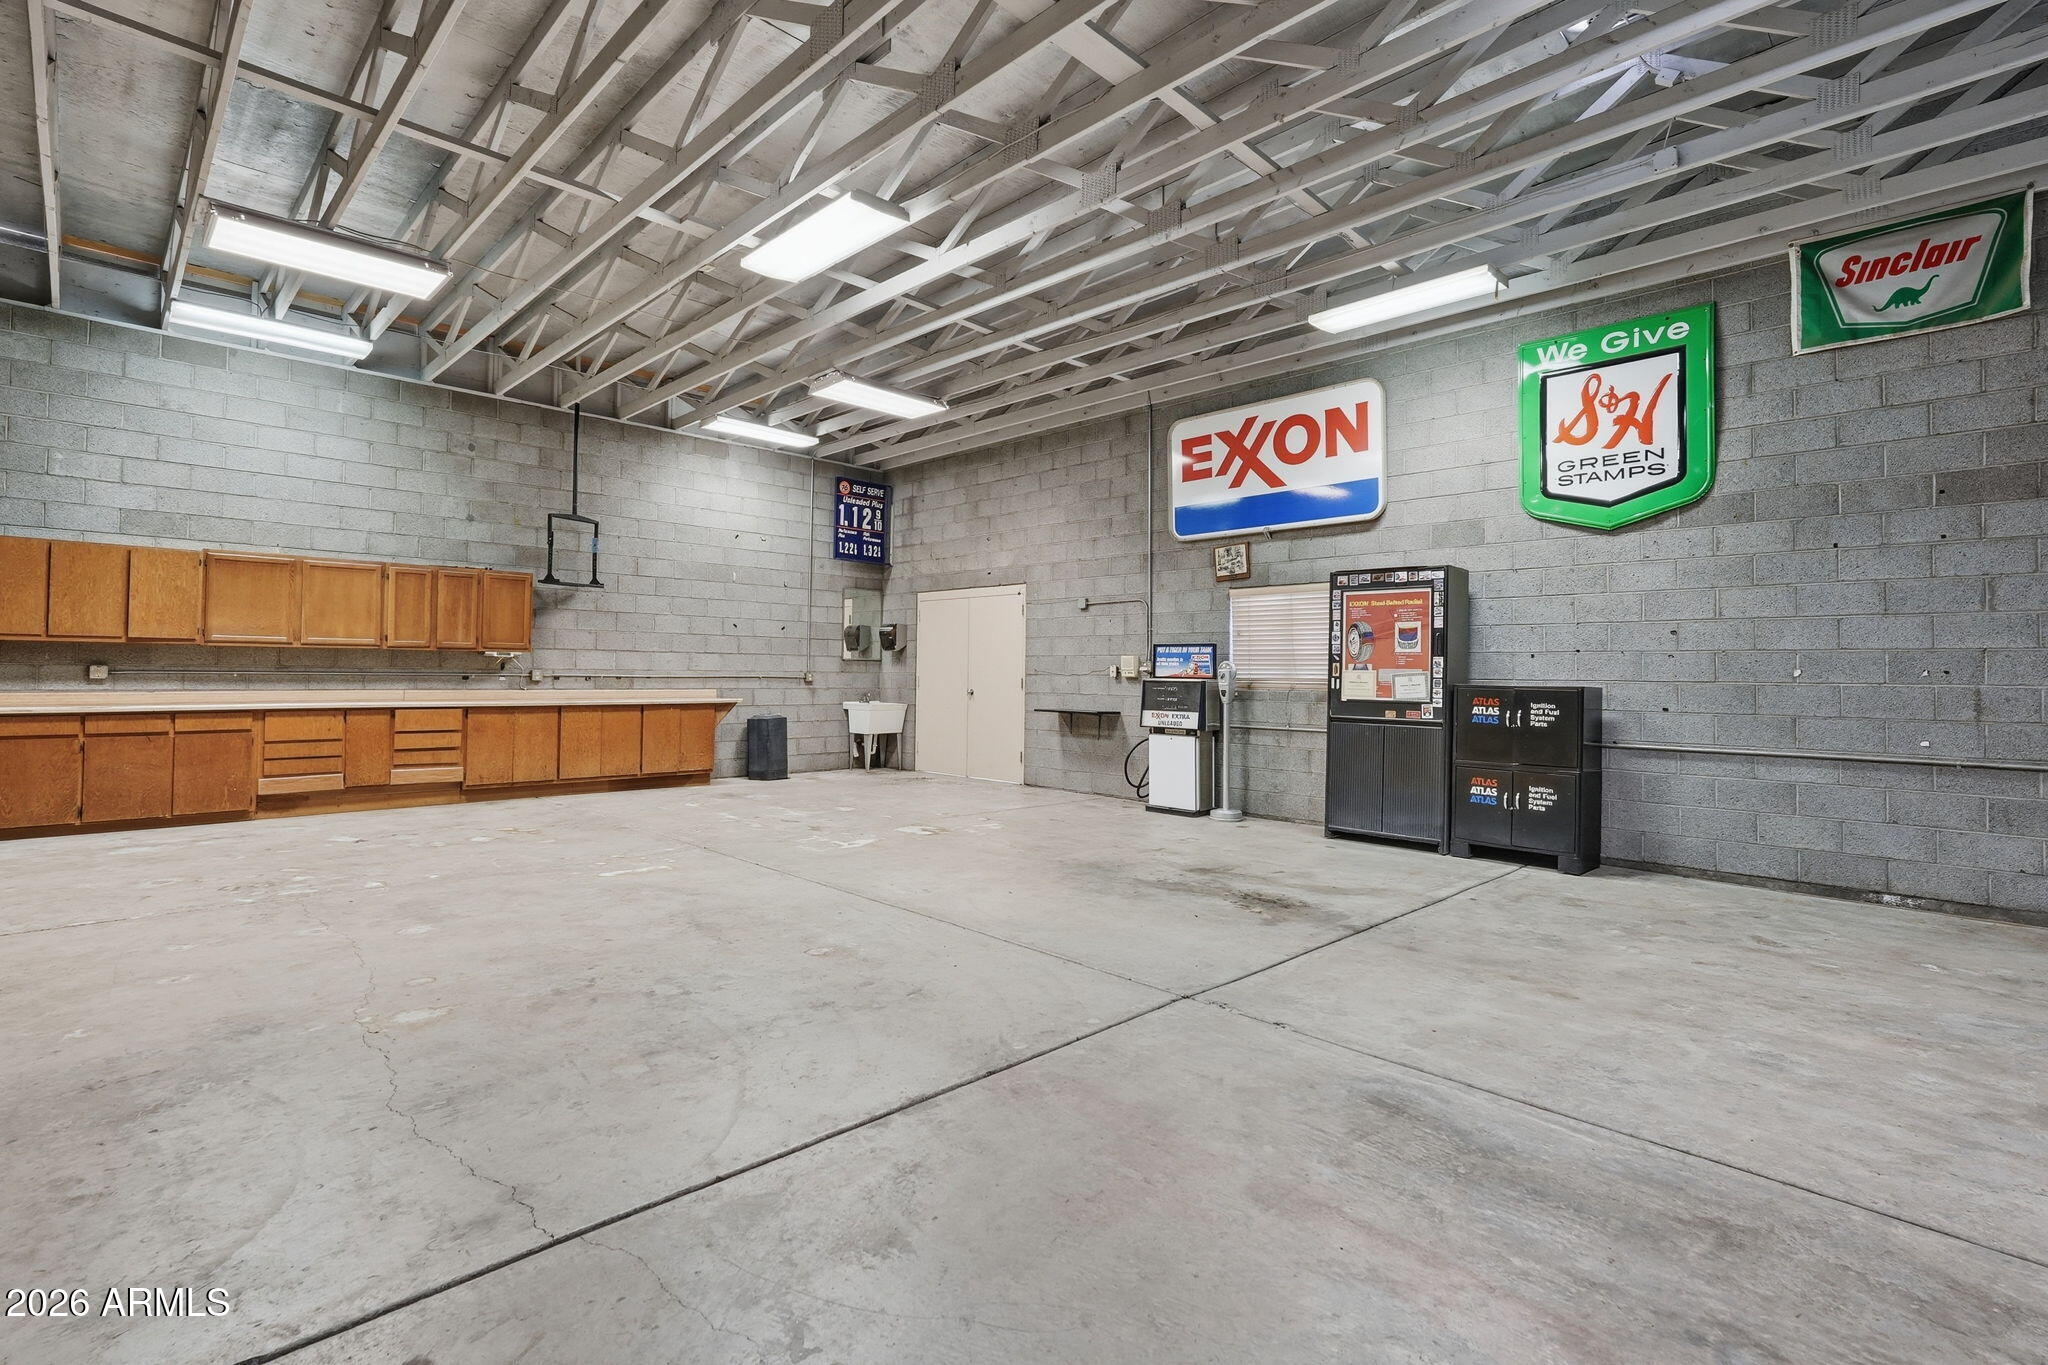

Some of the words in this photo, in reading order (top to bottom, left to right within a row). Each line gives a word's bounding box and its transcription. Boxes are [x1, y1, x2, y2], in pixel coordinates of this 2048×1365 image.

[1835, 234, 1983, 288] Sinclair
[1537, 342, 1588, 363] We
[1601, 321, 1690, 354] Give
[1552, 373, 1673, 449] S&H
[1181, 400, 1369, 489] EXXON
[1557, 447, 1665, 473] GREEN
[1557, 463, 1667, 487] STAMPS
[852, 484, 866, 494] SELF
[867, 487, 885, 497] SERVE
[843, 496, 870, 506] Unleaded
[871, 500, 883, 509] Plus
[874, 521, 883, 531] 10
[1472, 697, 1499, 706] ATLAS
[1472, 706, 1499, 715] ATLAS
[1472, 715, 1499, 724] ATLAS
[1530, 714, 1555, 722] System
[1470, 777, 1498, 787] ATLAS
[1470, 786, 1498, 796] ATLAS
[1528, 785, 1554, 794] Ignition
[1470, 795, 1497, 806] ATLAS
[1528, 798, 1553, 806] System
[1543, 793, 1558, 801] Fuel
[1528, 804, 1546, 812] Parts
